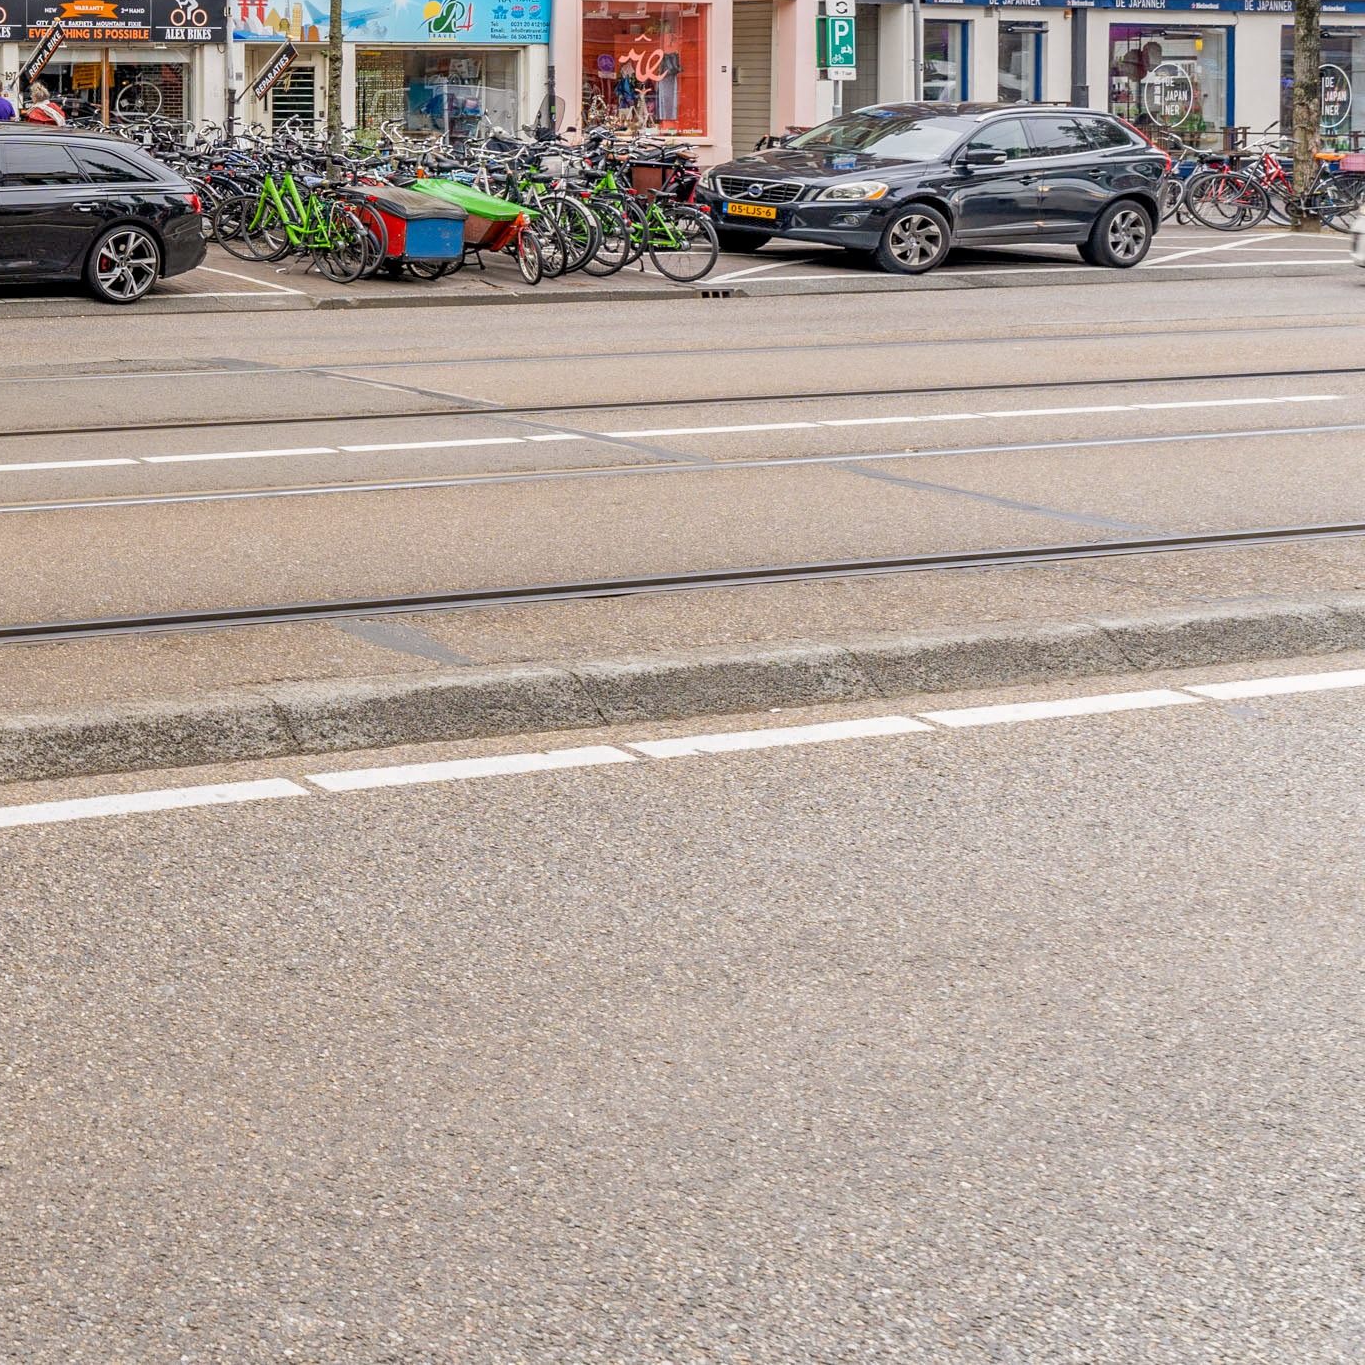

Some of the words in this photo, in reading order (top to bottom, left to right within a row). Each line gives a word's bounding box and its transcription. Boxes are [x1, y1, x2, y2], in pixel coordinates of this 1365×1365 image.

[1244, 0, 1254, 11] DE
[1256, 0, 1293, 12] JAPANNER
[94, 29, 103, 39] IS
[105, 29, 150, 39] POSSIBLE
[165, 28, 186, 39] ALEX
[187, 28, 212, 40] BIKES
[835, 20, 849, 46] P
[28, 54, 44, 77] RENT
[46, 30, 62, 51] BIKE
[254, 54, 289, 96] REPARATIES
[1165, 76, 1175, 87] DE
[1325, 77, 1335, 88] DE
[1165, 90, 1188, 101] JAPAN
[1325, 91, 1347, 102] JAPAN
[1165, 105, 1180, 116] NER
[1325, 105, 1340, 116] NER
[731, 204, 772, 217] 05-LJS-6
